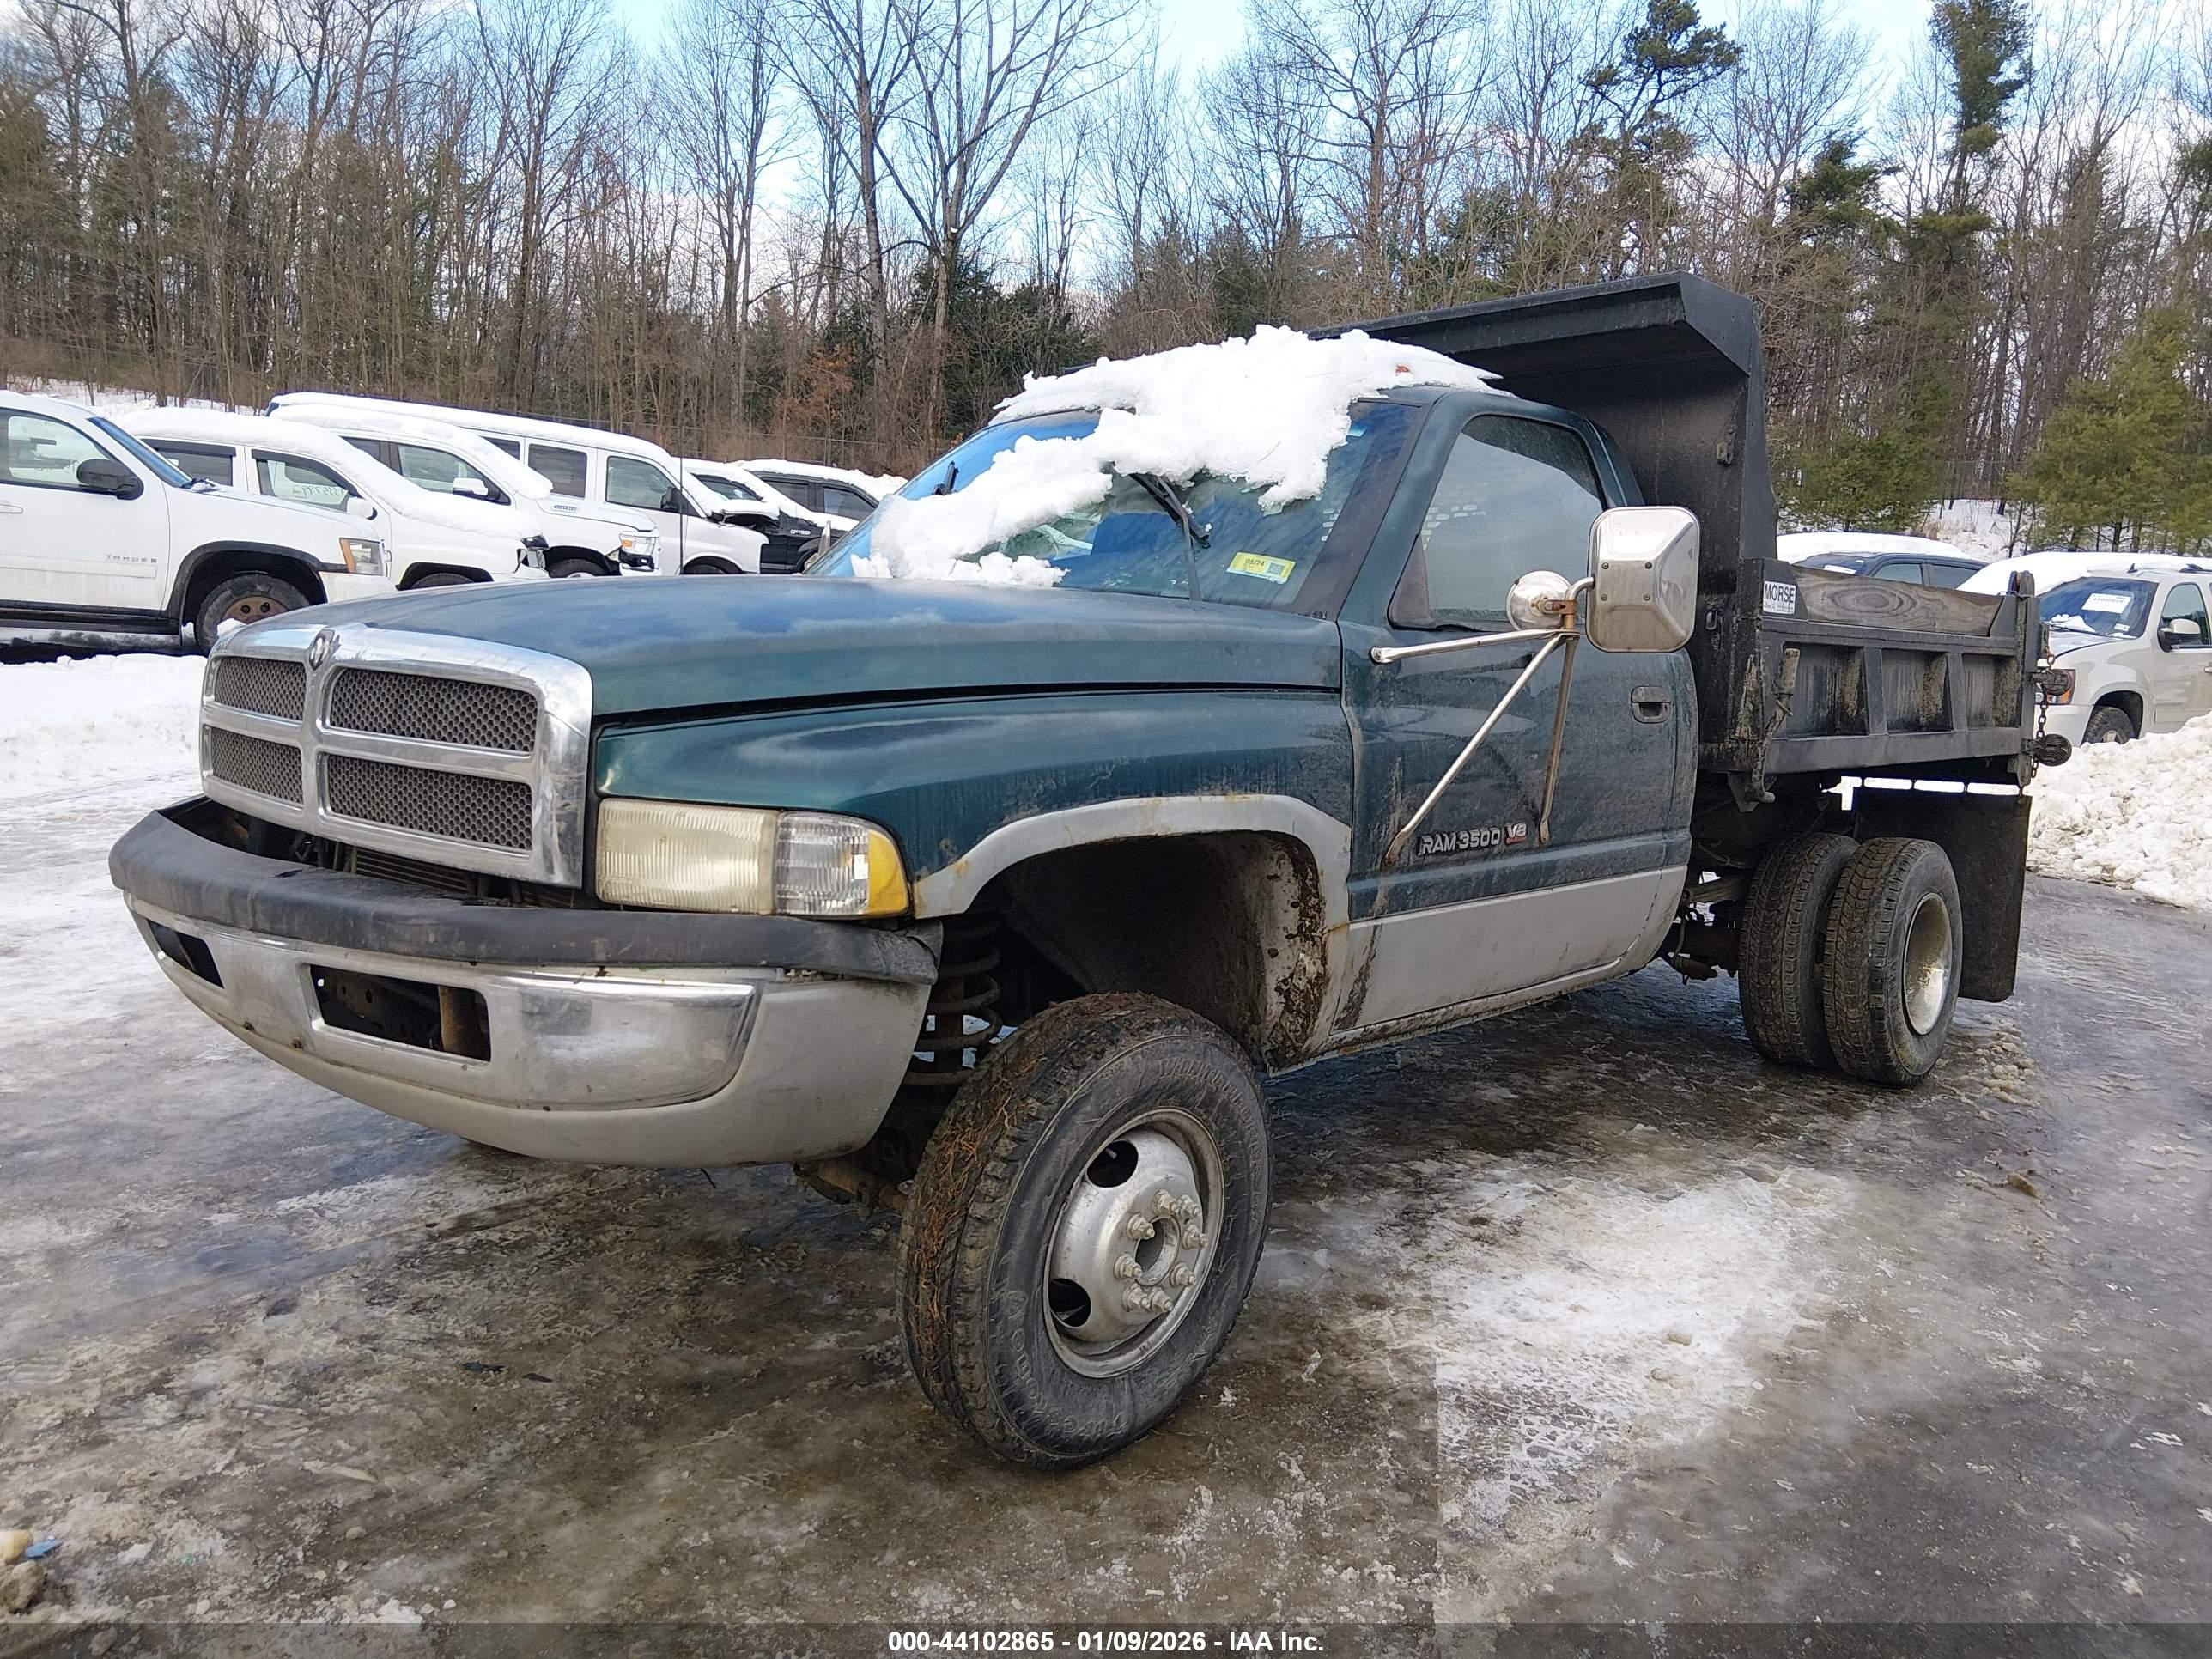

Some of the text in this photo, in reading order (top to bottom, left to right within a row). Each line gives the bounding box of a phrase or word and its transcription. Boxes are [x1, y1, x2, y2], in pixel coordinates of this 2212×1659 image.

[1764, 583, 1795, 603] MORSE
[1417, 823, 1527, 856] RAM 3500 V8
